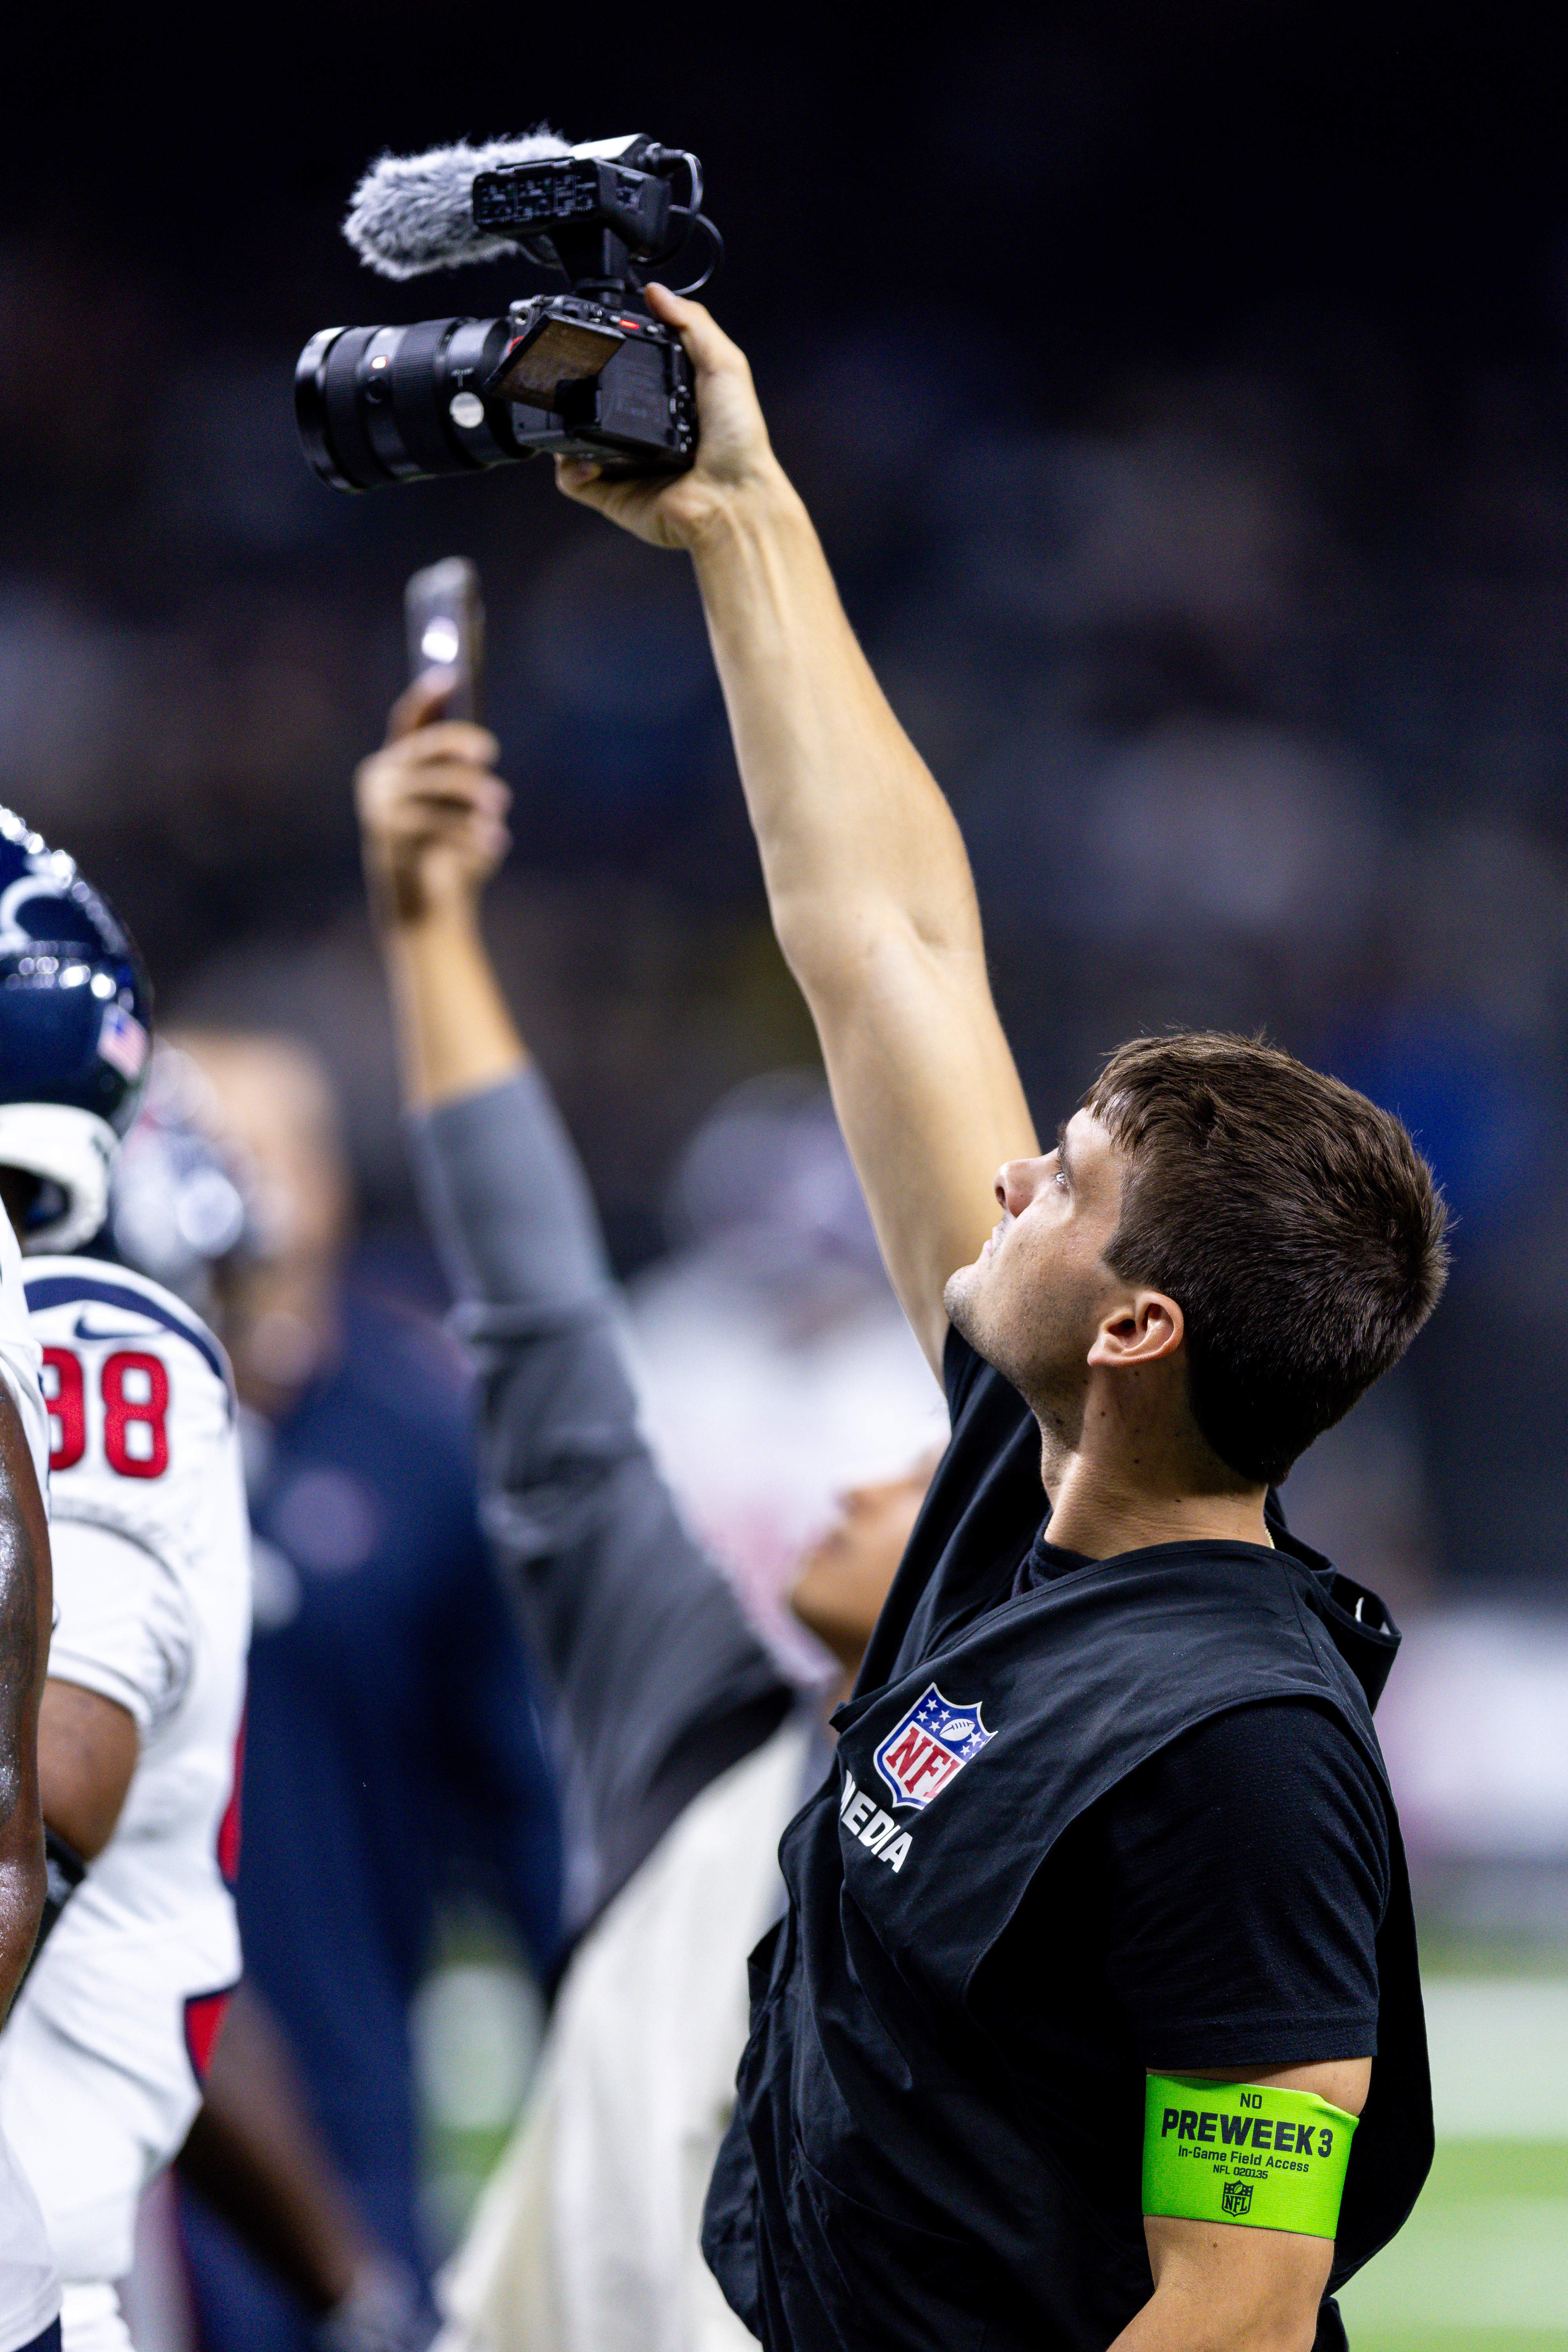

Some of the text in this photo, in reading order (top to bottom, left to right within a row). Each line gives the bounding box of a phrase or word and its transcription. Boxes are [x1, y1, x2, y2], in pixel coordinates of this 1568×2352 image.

[1240, 2092, 1262, 2109] NO
[1161, 2108, 1333, 2158] PREWEEK 3
[1178, 2145, 1309, 2172] In-Game Field Access
[1213, 2164, 1269, 2180] NFL 020135
[1224, 2194, 1248, 2213] NFL
